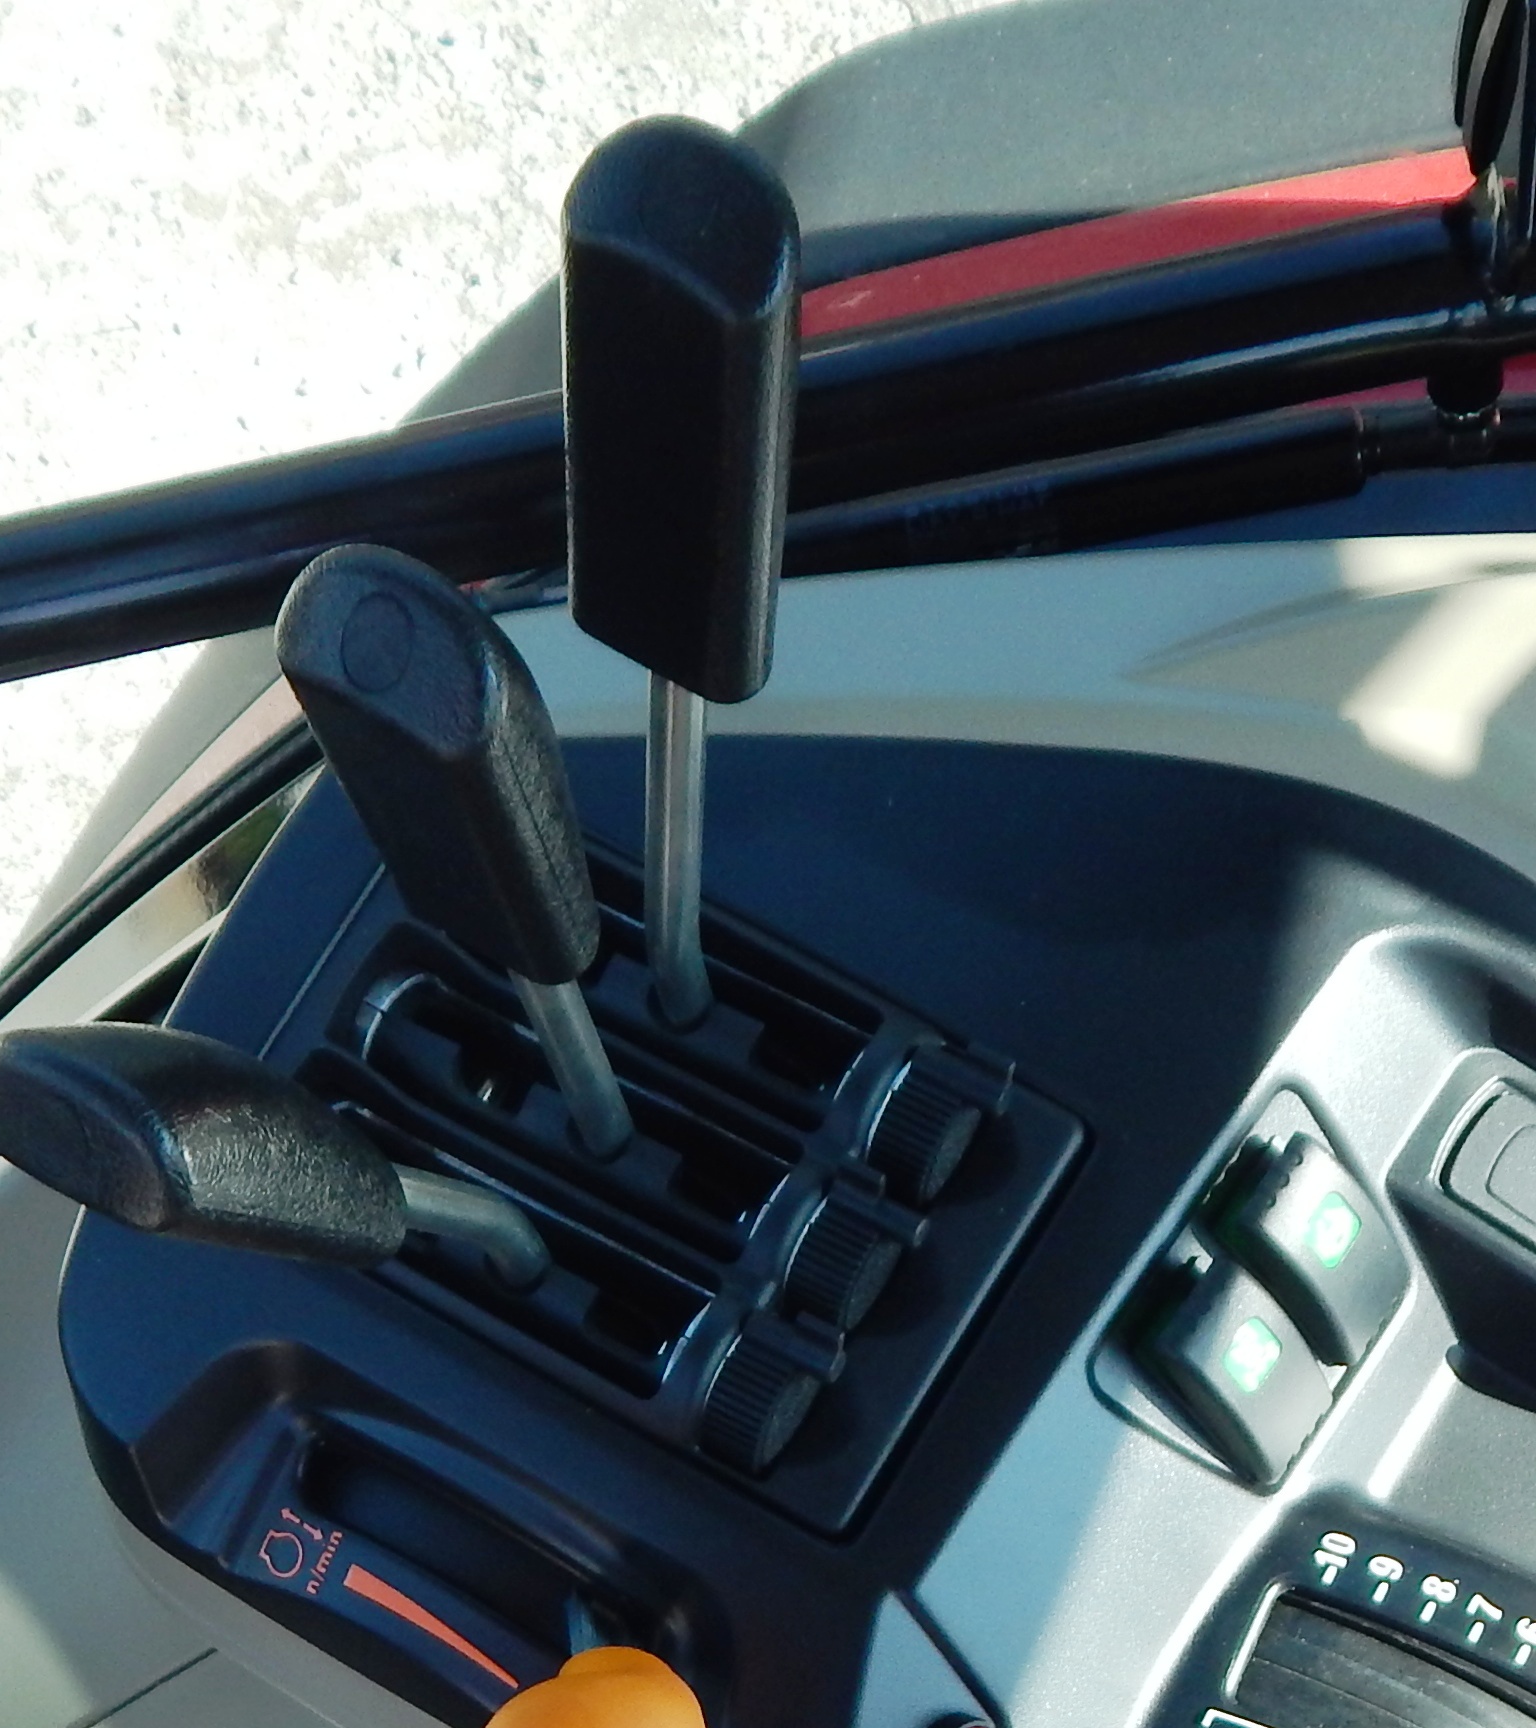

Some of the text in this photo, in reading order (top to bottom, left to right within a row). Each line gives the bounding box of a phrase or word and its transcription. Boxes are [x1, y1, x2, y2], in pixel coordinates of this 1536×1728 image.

[306, 1531, 343, 1594] n/min
[1314, 1532, 1356, 1569] 10
[1368, 1555, 1404, 1581] 9
[1421, 1575, 1457, 1603] 8
[1465, 1593, 1503, 1621] 7
